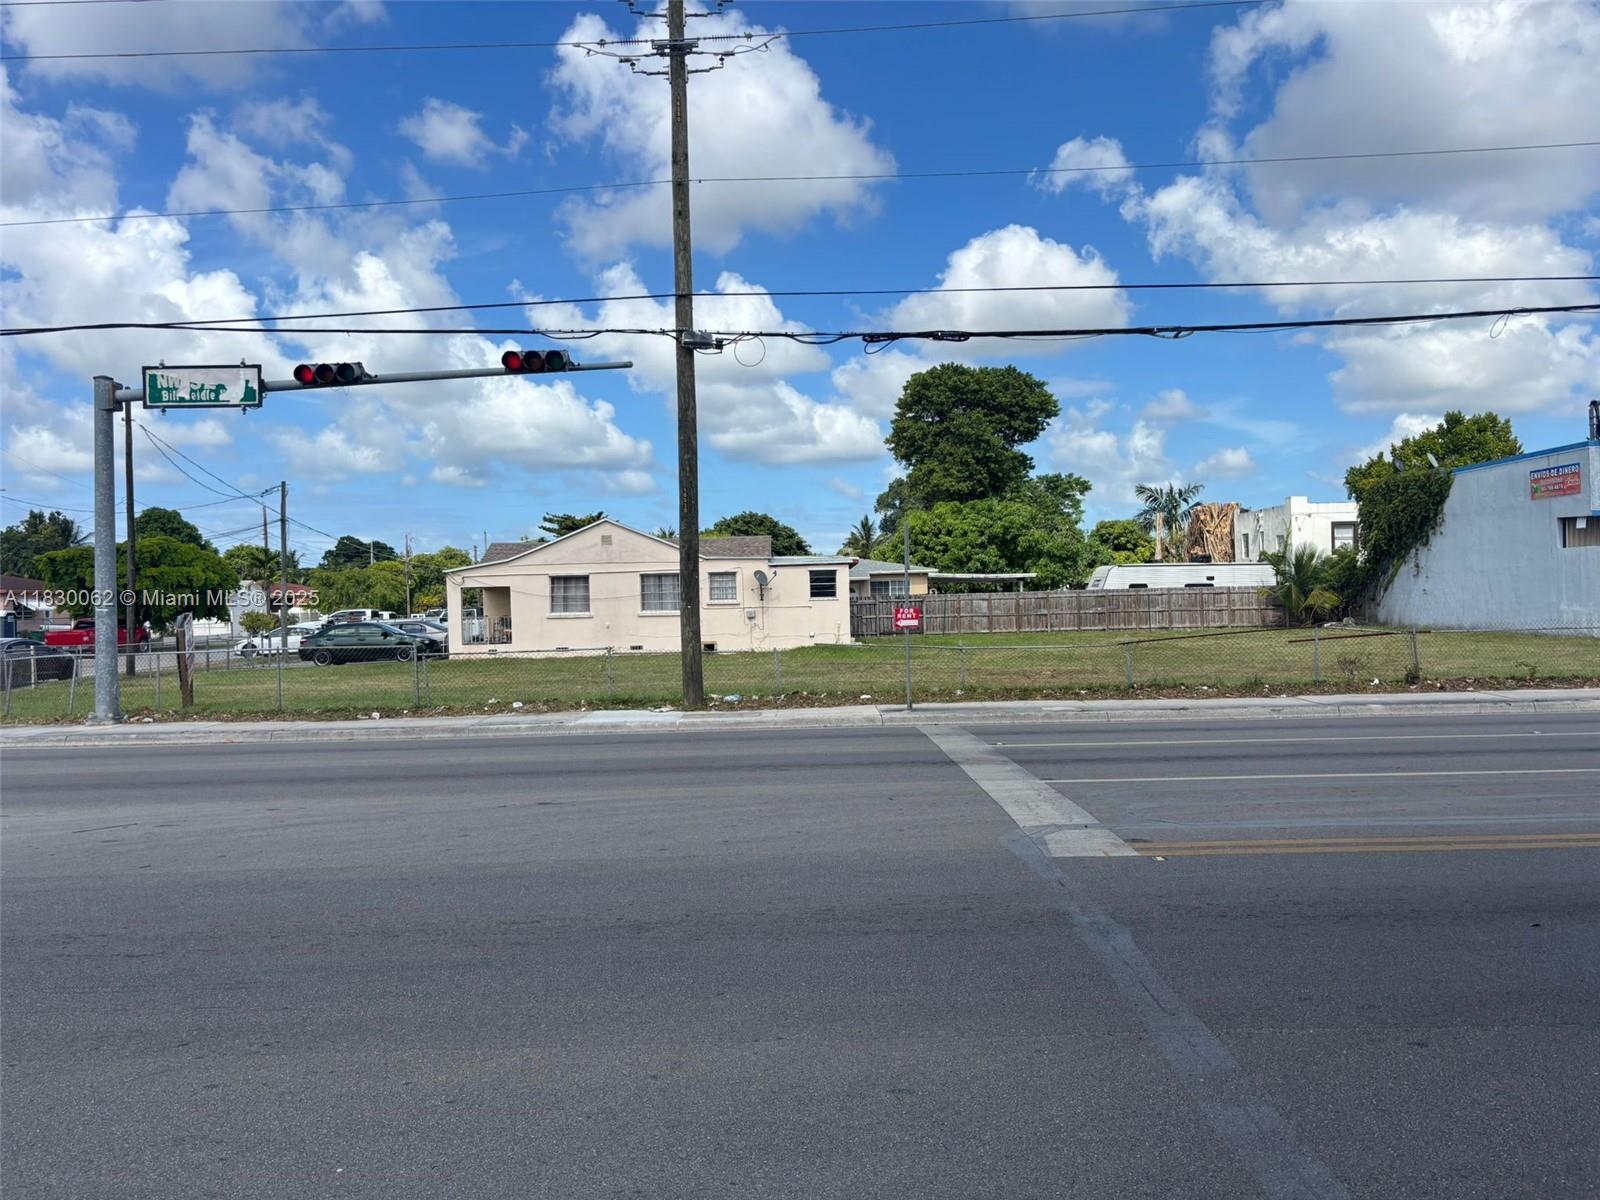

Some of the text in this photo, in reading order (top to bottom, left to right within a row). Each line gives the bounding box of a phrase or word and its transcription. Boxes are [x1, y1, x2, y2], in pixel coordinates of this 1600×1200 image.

[1531, 469, 1550, 480] ENVIOS
[1550, 468, 1558, 477] DE
[1559, 465, 1579, 475] DINERO
